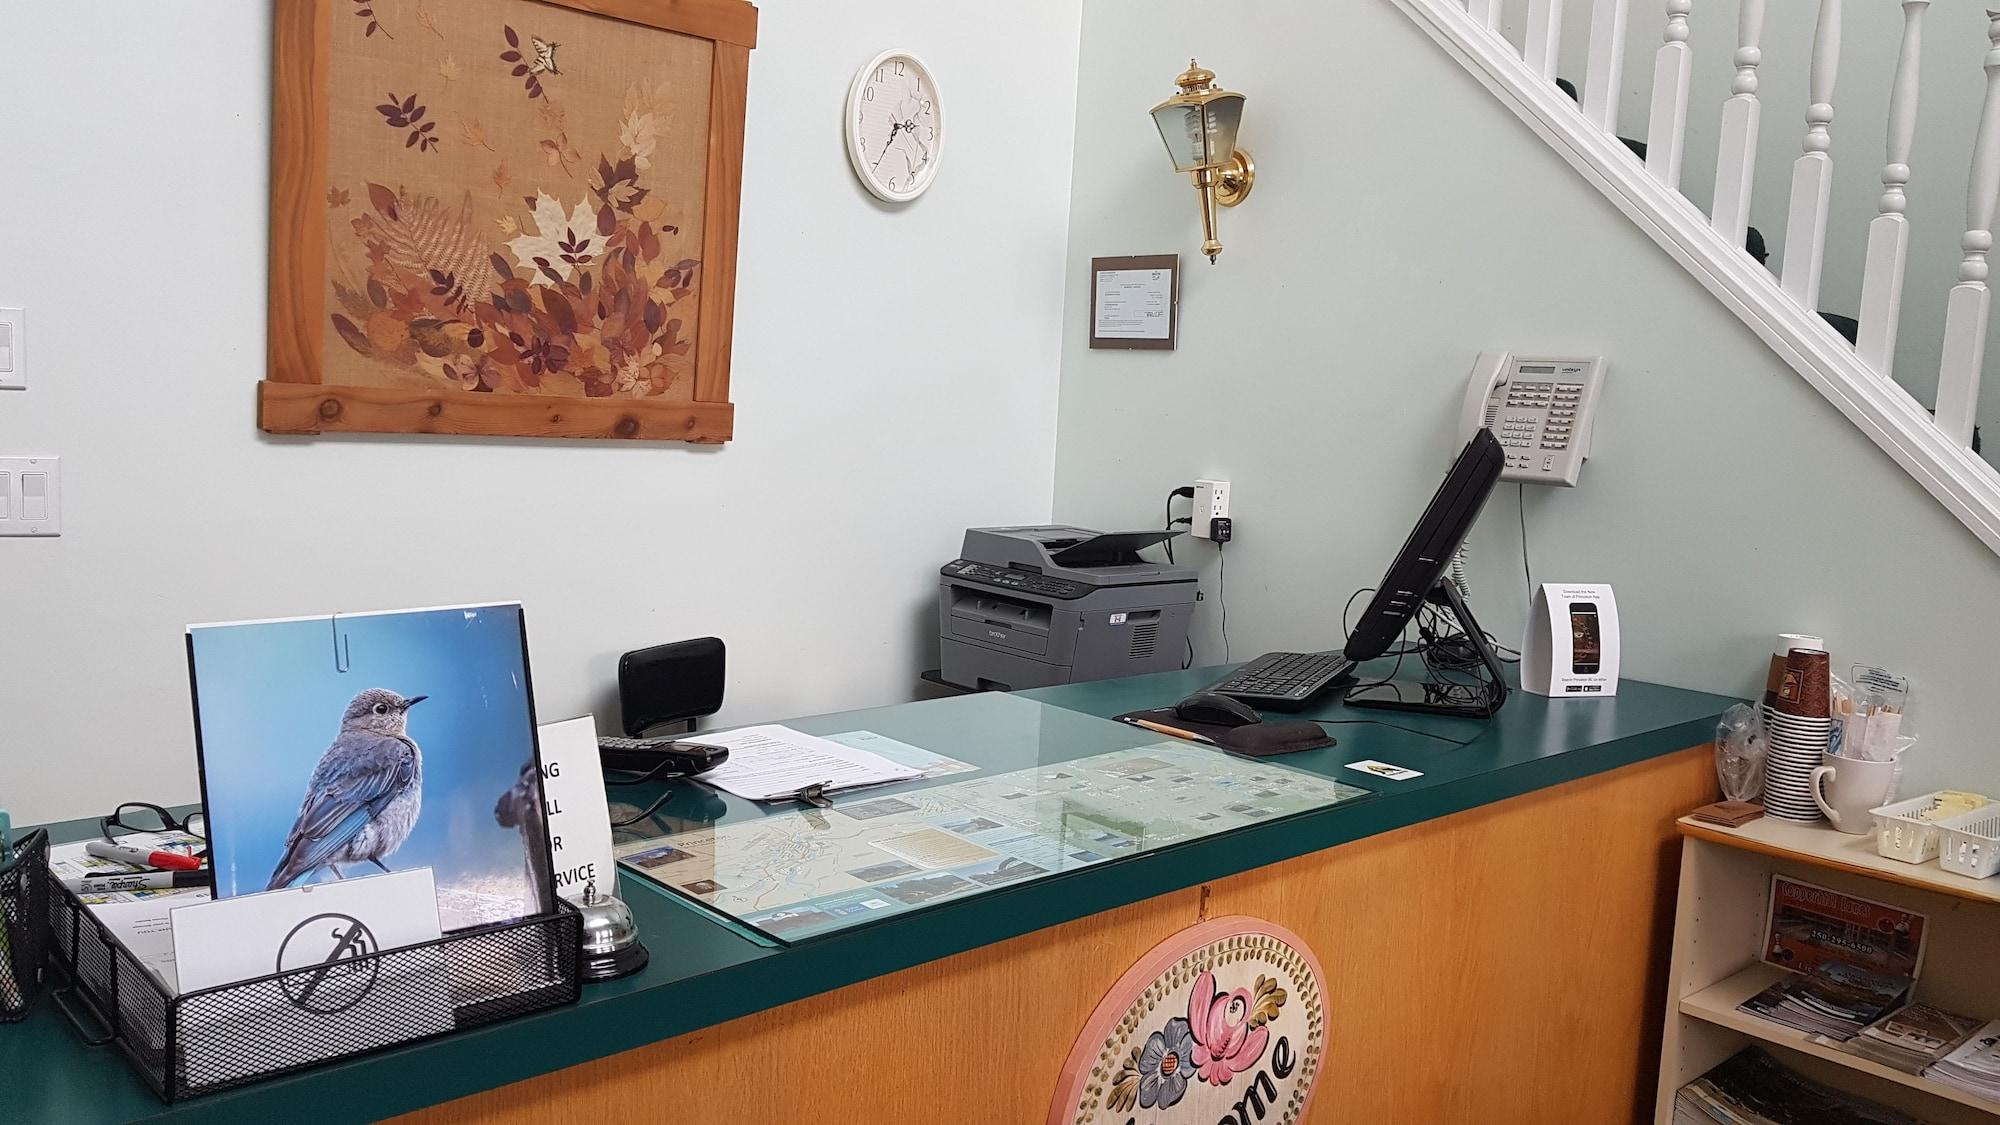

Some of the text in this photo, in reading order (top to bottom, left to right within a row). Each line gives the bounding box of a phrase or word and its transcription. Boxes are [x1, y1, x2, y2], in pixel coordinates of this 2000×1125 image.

[875, 69, 884, 83] 11
[894, 60, 905, 76] 12
[888, 177, 896, 192] 6
[541, 762, 560, 779] NG
[546, 799, 562, 816] LL
[555, 863, 596, 888] RVICE
